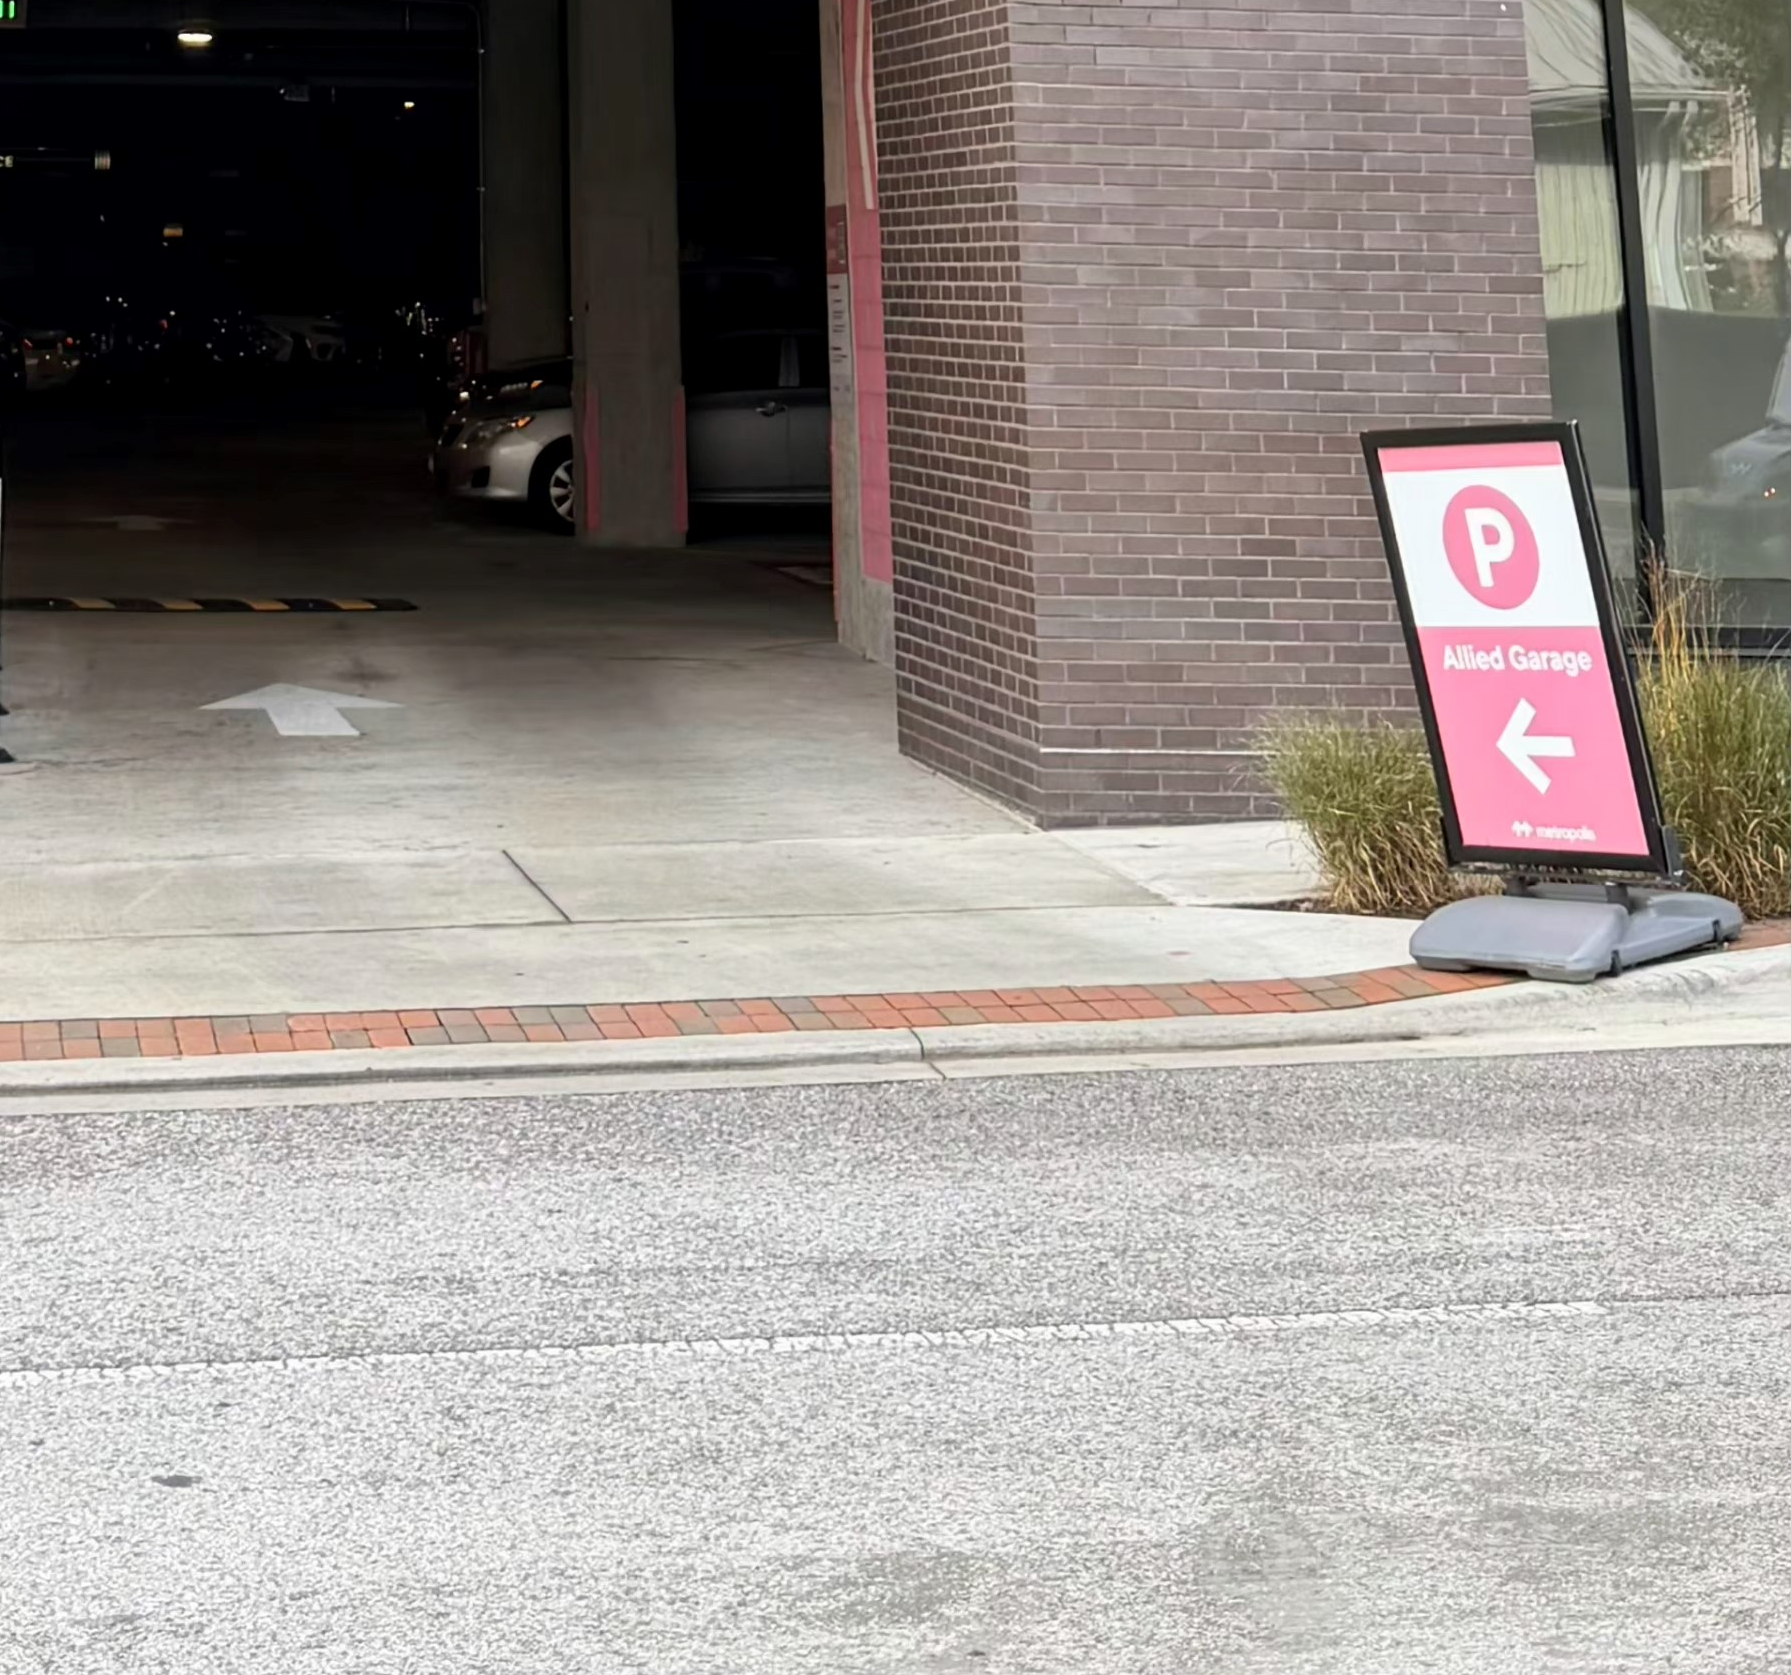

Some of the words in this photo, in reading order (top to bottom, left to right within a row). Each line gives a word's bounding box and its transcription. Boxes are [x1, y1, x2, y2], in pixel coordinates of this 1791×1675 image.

[1463, 506, 1516, 588] P
[1442, 643, 1506, 671] Allied
[1508, 643, 1594, 678] Garage
